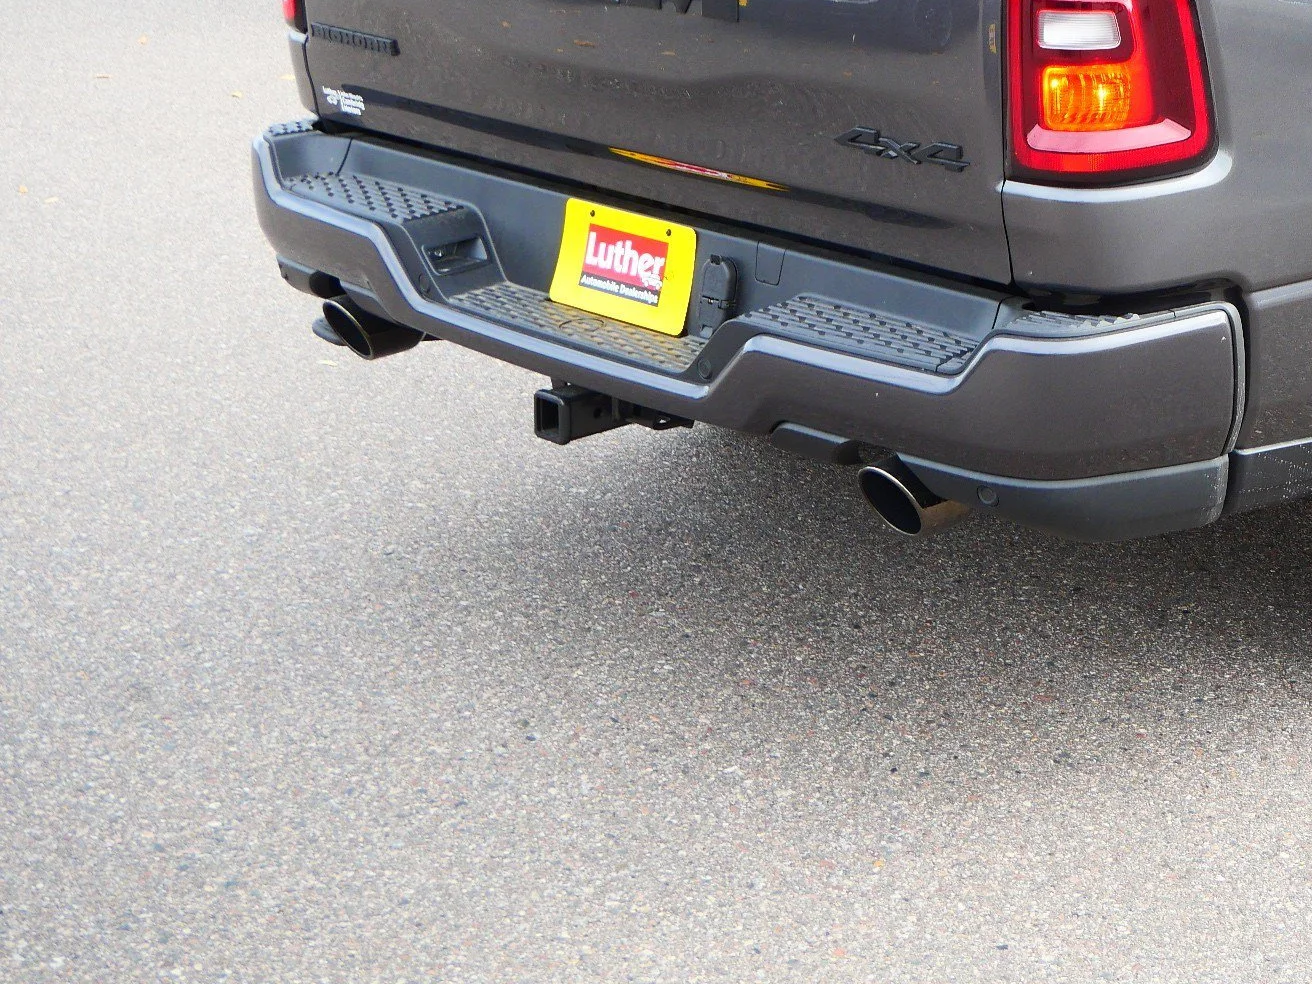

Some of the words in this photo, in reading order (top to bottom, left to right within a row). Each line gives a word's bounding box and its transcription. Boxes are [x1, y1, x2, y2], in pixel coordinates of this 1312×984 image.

[584, 231, 666, 278] Luther
[580, 274, 620, 293] Automobile
[620, 284, 659, 305] Dealerships
